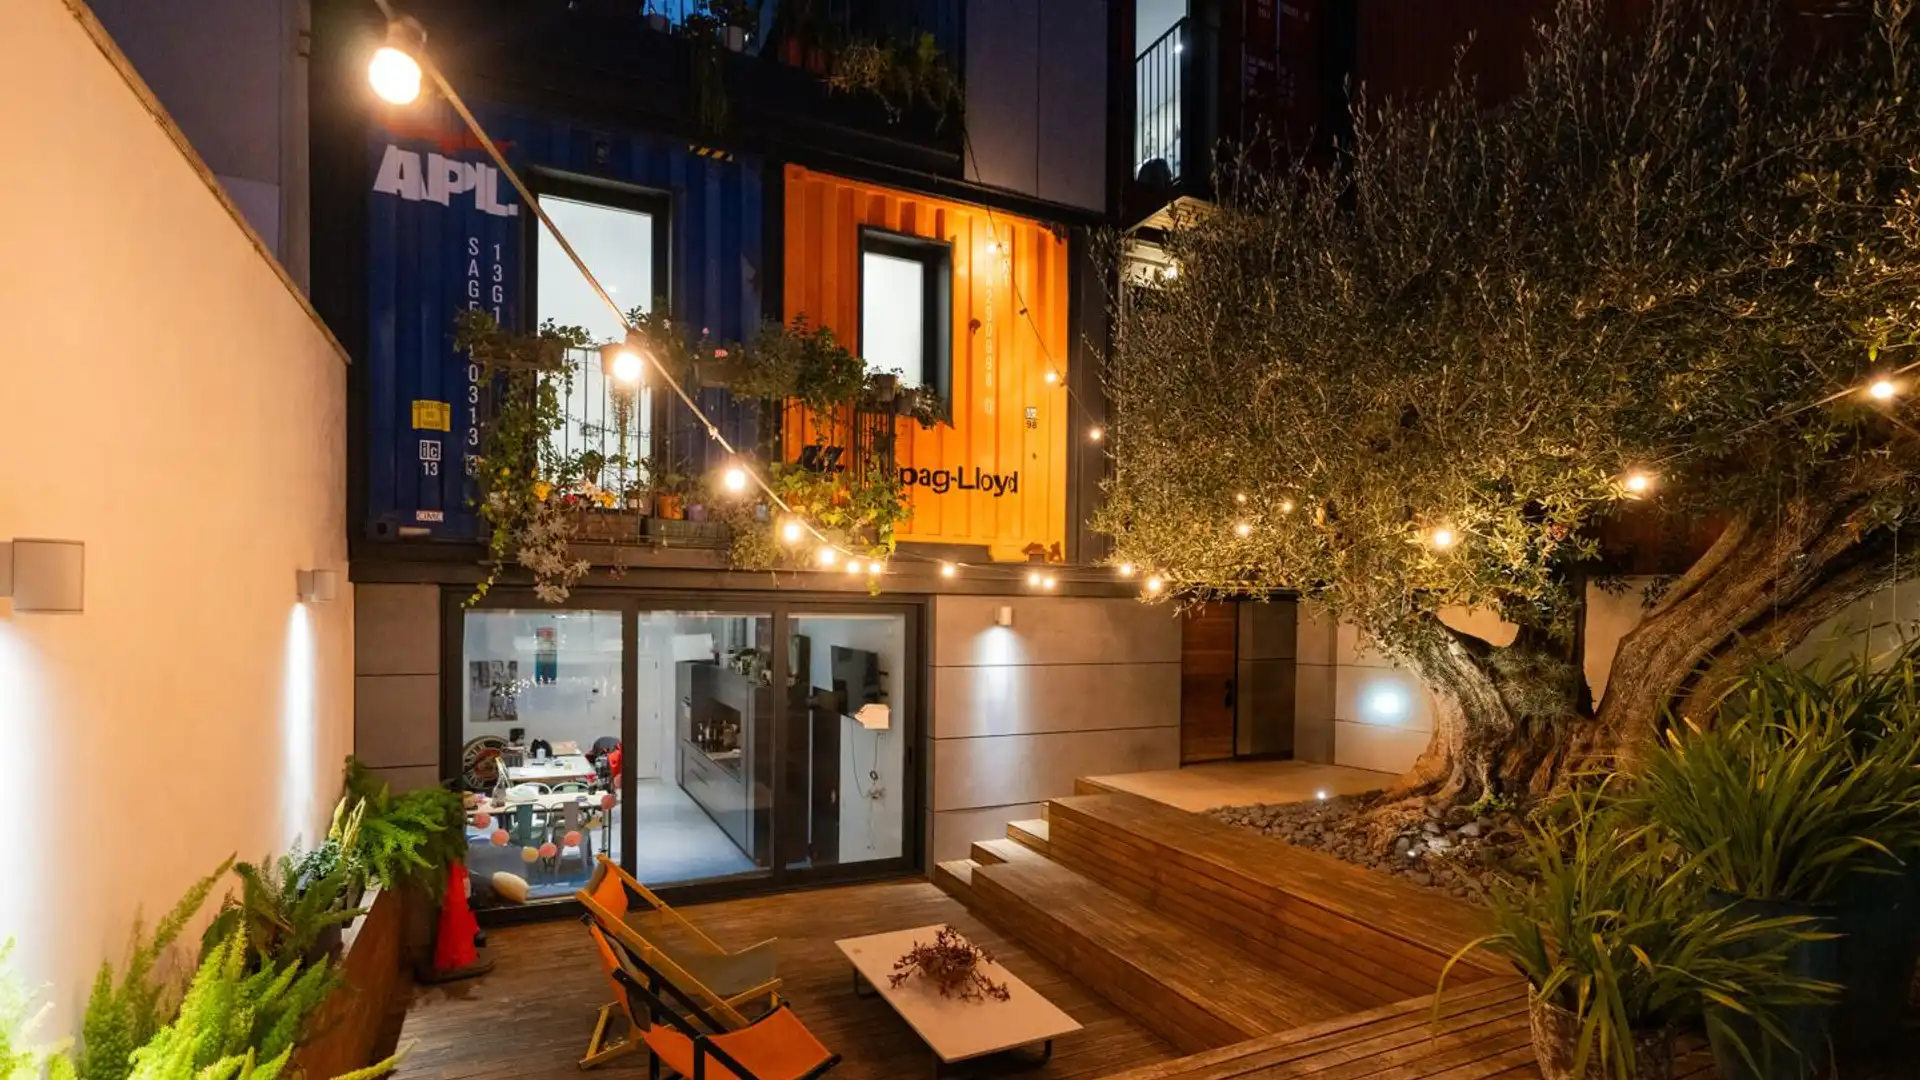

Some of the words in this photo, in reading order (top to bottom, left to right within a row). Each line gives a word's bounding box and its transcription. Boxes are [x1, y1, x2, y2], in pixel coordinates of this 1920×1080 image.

[373, 145, 518, 216] APL
[422, 462, 439, 476] 13
[898, 465, 1018, 497] pag-Lloyd
